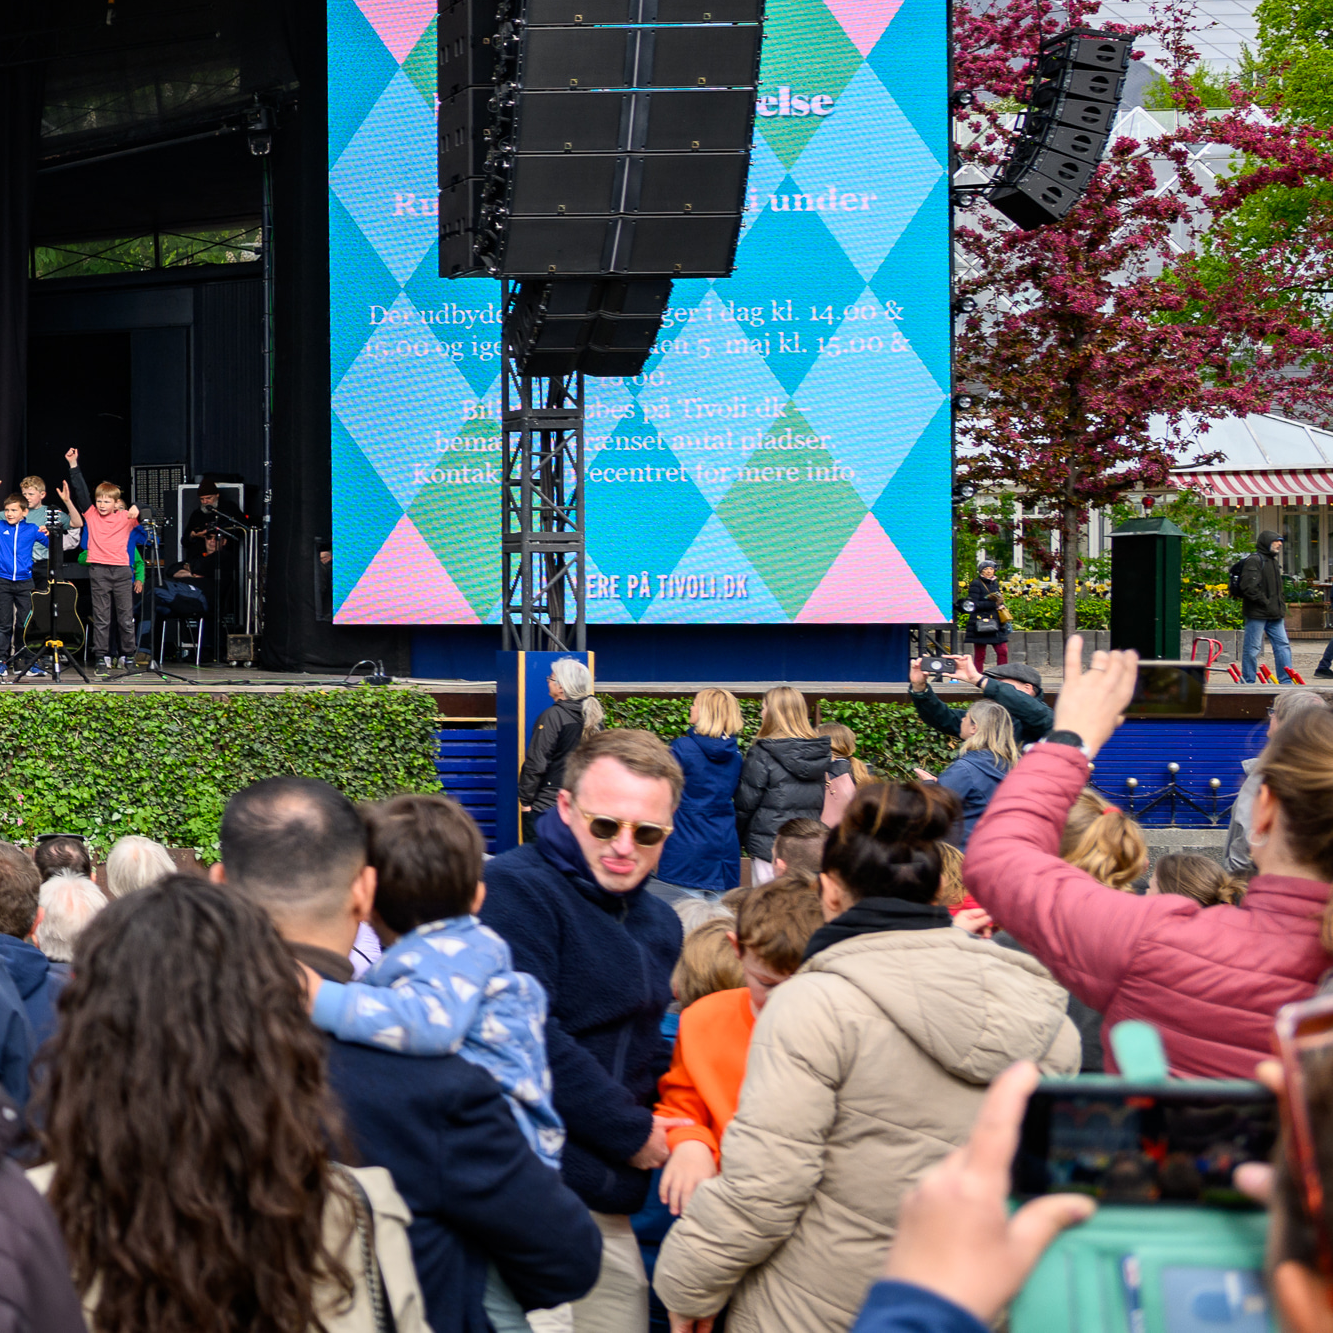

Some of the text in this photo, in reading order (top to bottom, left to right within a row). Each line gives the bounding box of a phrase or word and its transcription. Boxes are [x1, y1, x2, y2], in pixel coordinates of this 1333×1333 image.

[767, 185, 878, 213] under
[368, 305, 413, 326] Der
[720, 299, 765, 328] dag
[771, 299, 801, 322] kl.
[809, 304, 876, 326] 14.00
[884, 299, 905, 322] &
[437, 339, 464, 362] og
[726, 332, 771, 358] maj
[778, 331, 808, 354] kl.
[816, 335, 884, 359] 15.00
[890, 331, 911, 354] &
[643, 396, 671, 425] på
[671, 431, 734, 451] antal
[740, 427, 837, 457] pladser.
[738, 466, 800, 484] mere
[627, 570, 652, 600] PÅ
[656, 574, 749, 600] TIVOLI.DK
